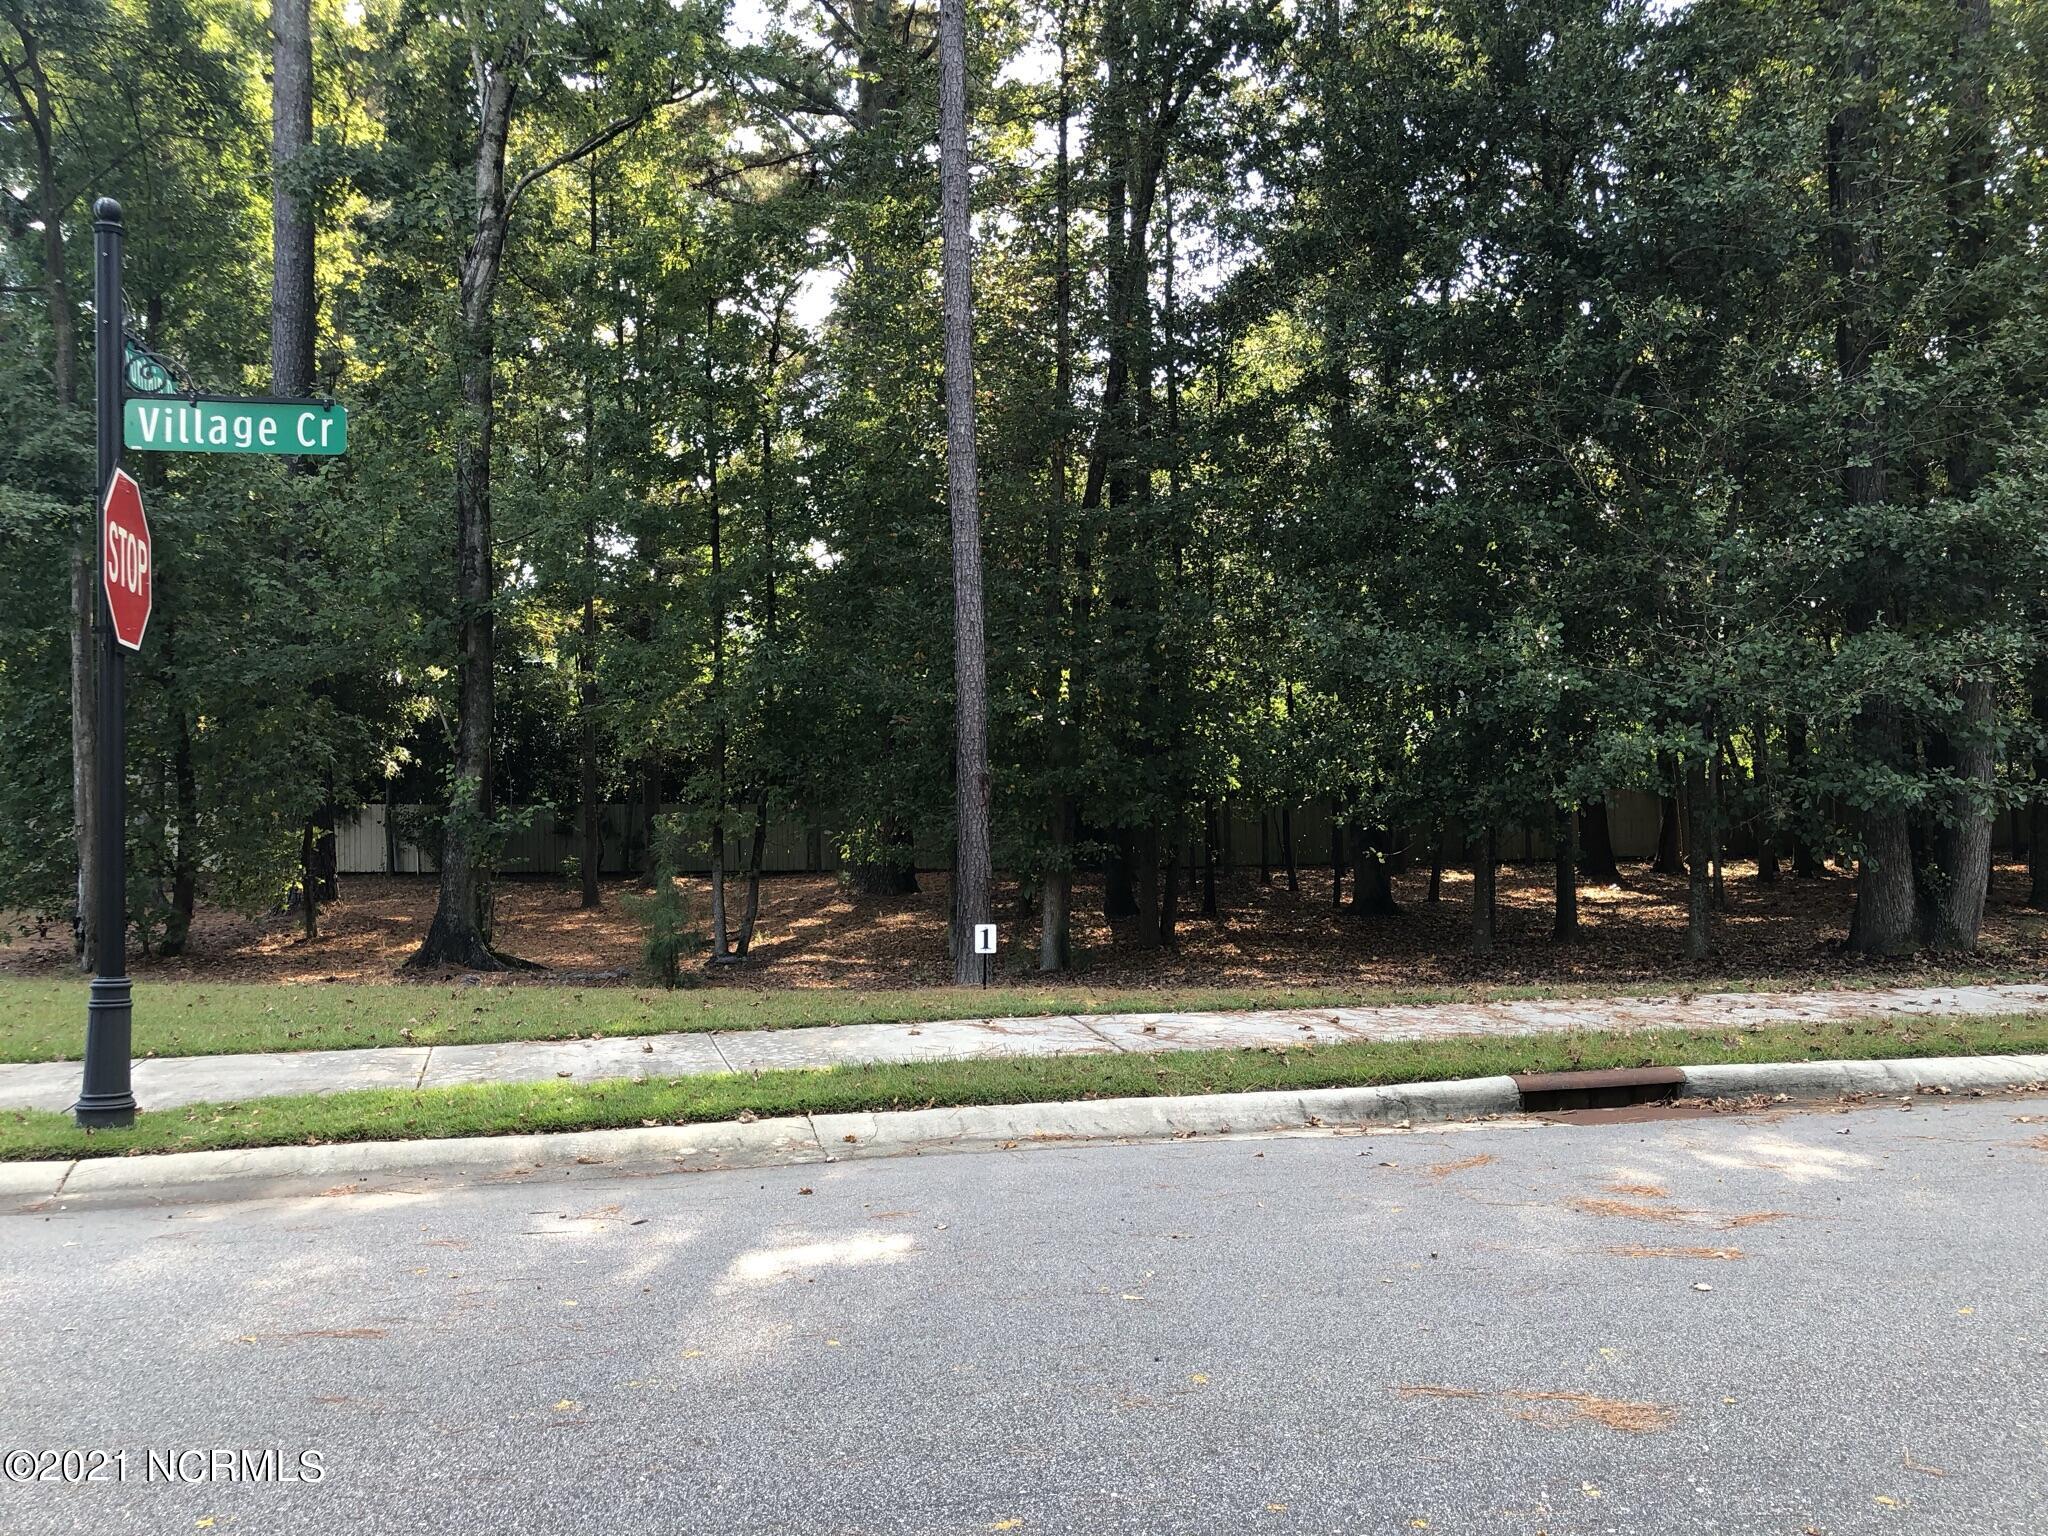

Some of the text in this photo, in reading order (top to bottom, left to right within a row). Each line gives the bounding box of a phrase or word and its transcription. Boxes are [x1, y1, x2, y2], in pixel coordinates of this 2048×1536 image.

[137, 406, 334, 448] Village Cr
[108, 520, 148, 596] STOP
[980, 928, 992, 950] 1
